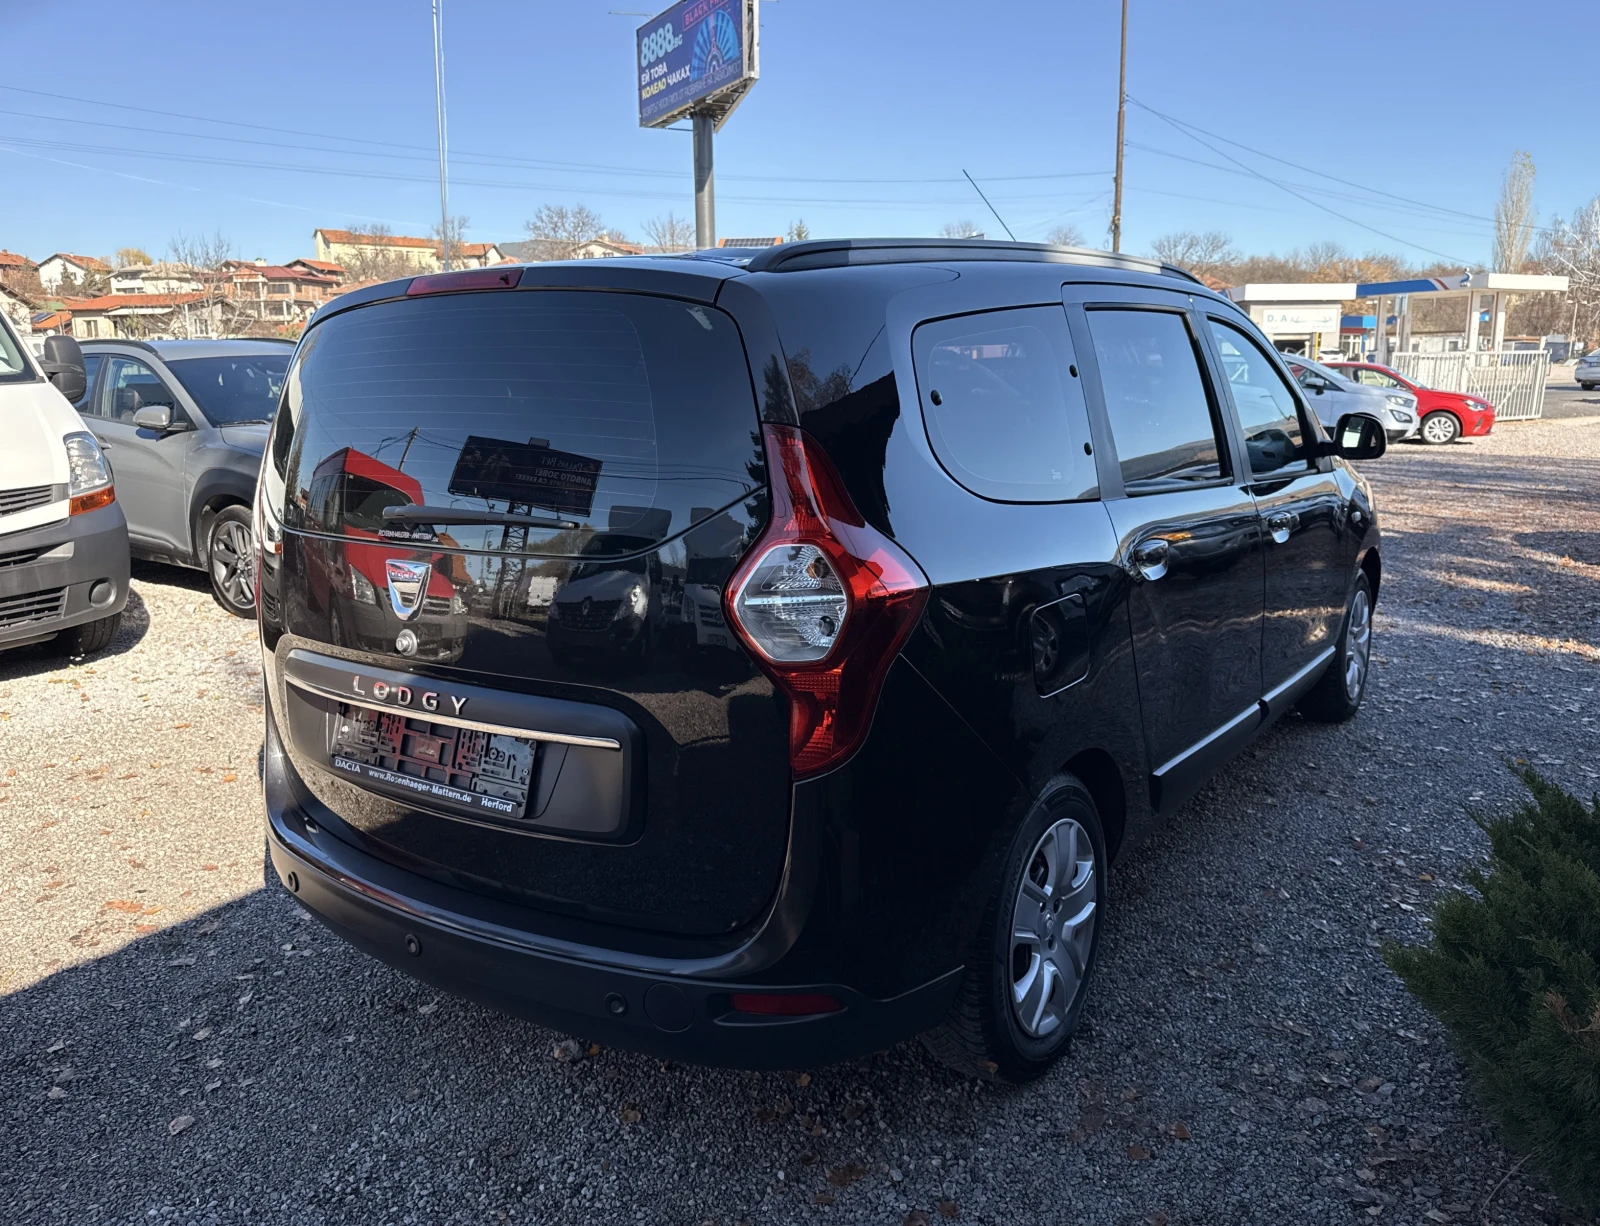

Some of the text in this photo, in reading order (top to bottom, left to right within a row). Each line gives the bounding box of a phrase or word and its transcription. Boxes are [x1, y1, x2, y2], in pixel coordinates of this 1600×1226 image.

[641, 62, 668, 86] ЕЙ ТОВА
[641, 64, 691, 101] КОЛЕЛО ЧАКАХ
[353, 675, 467, 715] LODGY
[335, 758, 513, 813] DACIA www.Rosenhaeger-Mattern.de Herford
